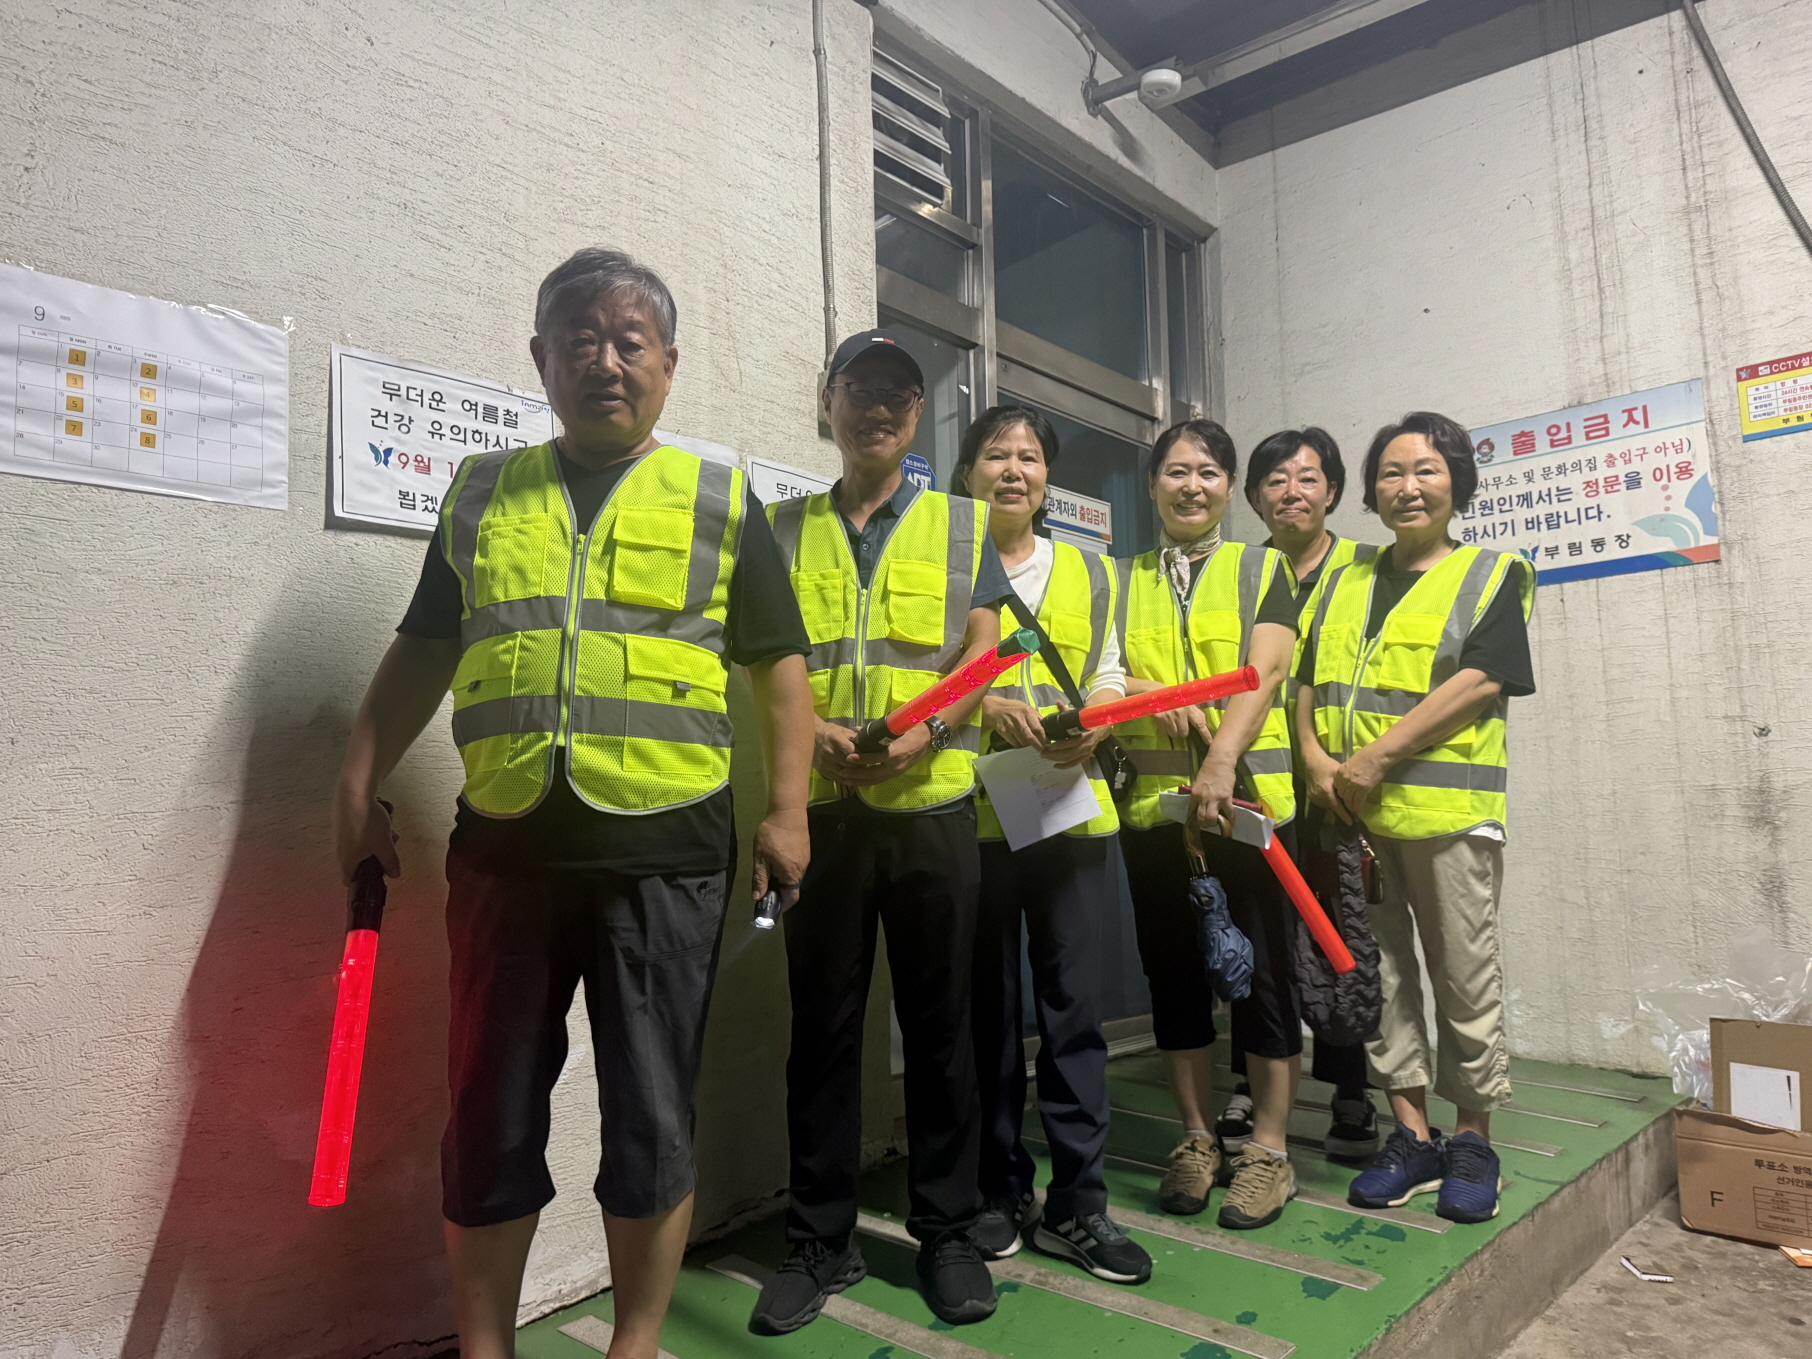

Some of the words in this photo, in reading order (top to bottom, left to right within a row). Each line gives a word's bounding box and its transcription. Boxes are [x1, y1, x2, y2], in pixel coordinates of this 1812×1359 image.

[34, 305, 45, 322] 9
[146, 367, 152, 375] 2
[1772, 355, 1812, 372] CCTV설
[381, 380, 446, 412] 무더운
[461, 399, 519, 430] 여름철
[71, 424, 77, 432] 7
[370, 407, 415, 435] 건강
[1511, 404, 1650, 457] 출입금지
[397, 452, 431, 476] 9월
[1522, 469, 1536, 485] 및
[1540, 456, 1597, 481] 문화의집
[1603, 446, 1649, 469] 출입구
[1654, 437, 1692, 458] 아님)
[1582, 471, 1643, 499] 정문을
[1652, 460, 1695, 483] 이용
[1048, 496, 1077, 520] 관계자외
[1079, 505, 1107, 528] 출입금지
[1461, 519, 1515, 543] 하시기
[1525, 504, 1611, 533] 바랍니다.
[1754, 1159, 1789, 1173] 투표소
[1710, 1190, 1724, 1207] F
